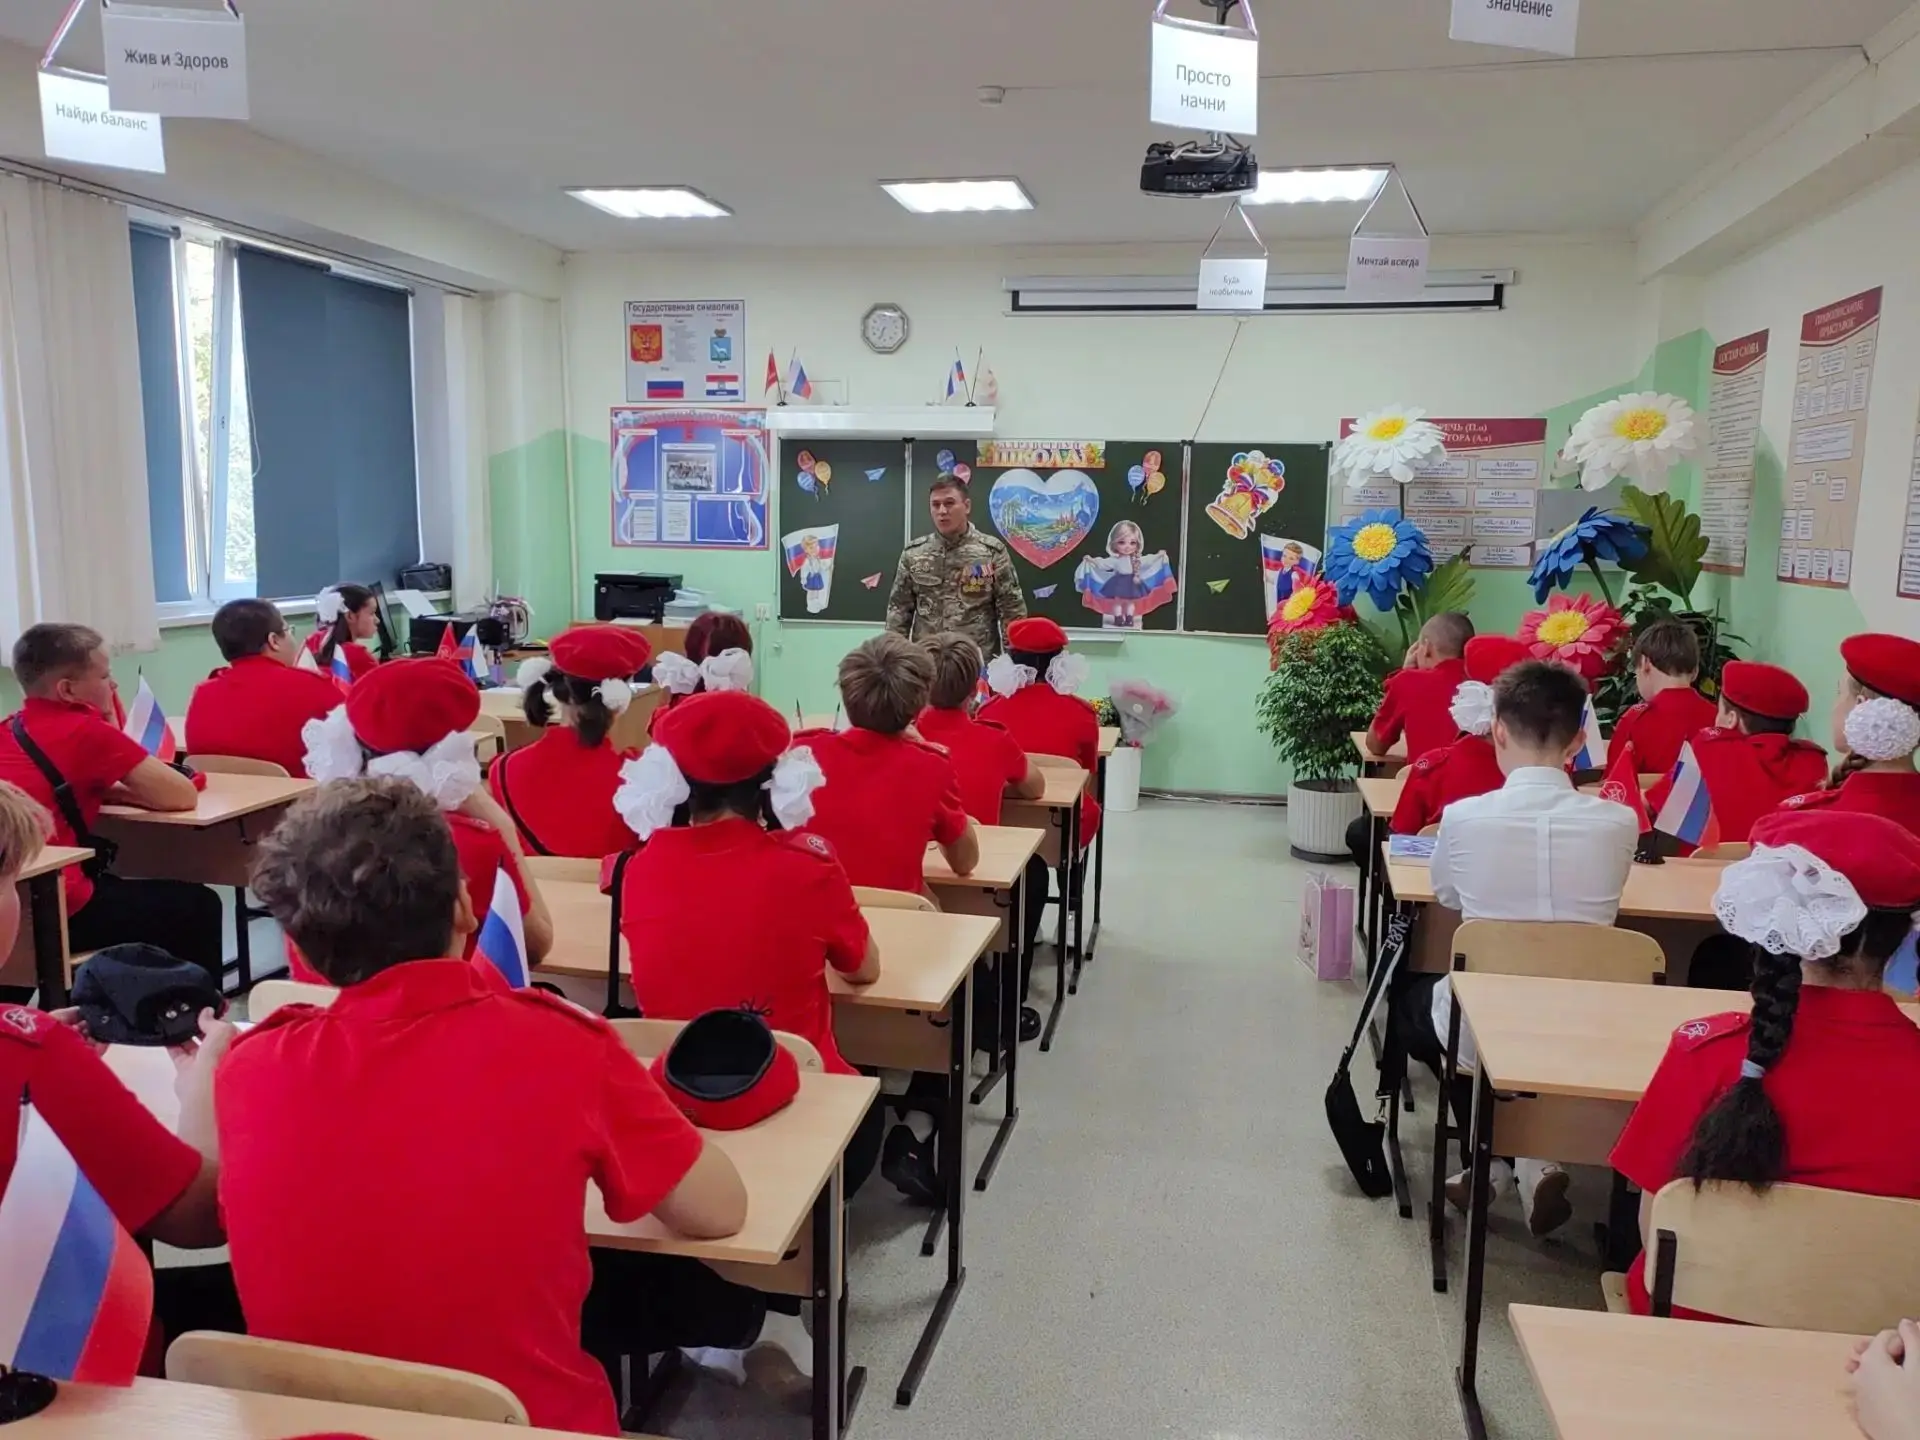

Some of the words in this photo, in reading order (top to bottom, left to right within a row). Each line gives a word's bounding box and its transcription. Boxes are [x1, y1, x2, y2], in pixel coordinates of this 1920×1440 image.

[124, 48, 157, 66] Жив
[160, 53, 171, 66] и
[174, 51, 229, 71] Здоров
[1175, 64, 1231, 87] Просто
[1180, 93, 1226, 112] начни
[55, 103, 97, 124] Найди
[100, 112, 148, 131] баланс
[1357, 256, 1389, 267] Мечтай
[1391, 258, 1420, 268] всегда
[628, 302, 695, 313] Государственная
[697, 302, 740, 312] символика
